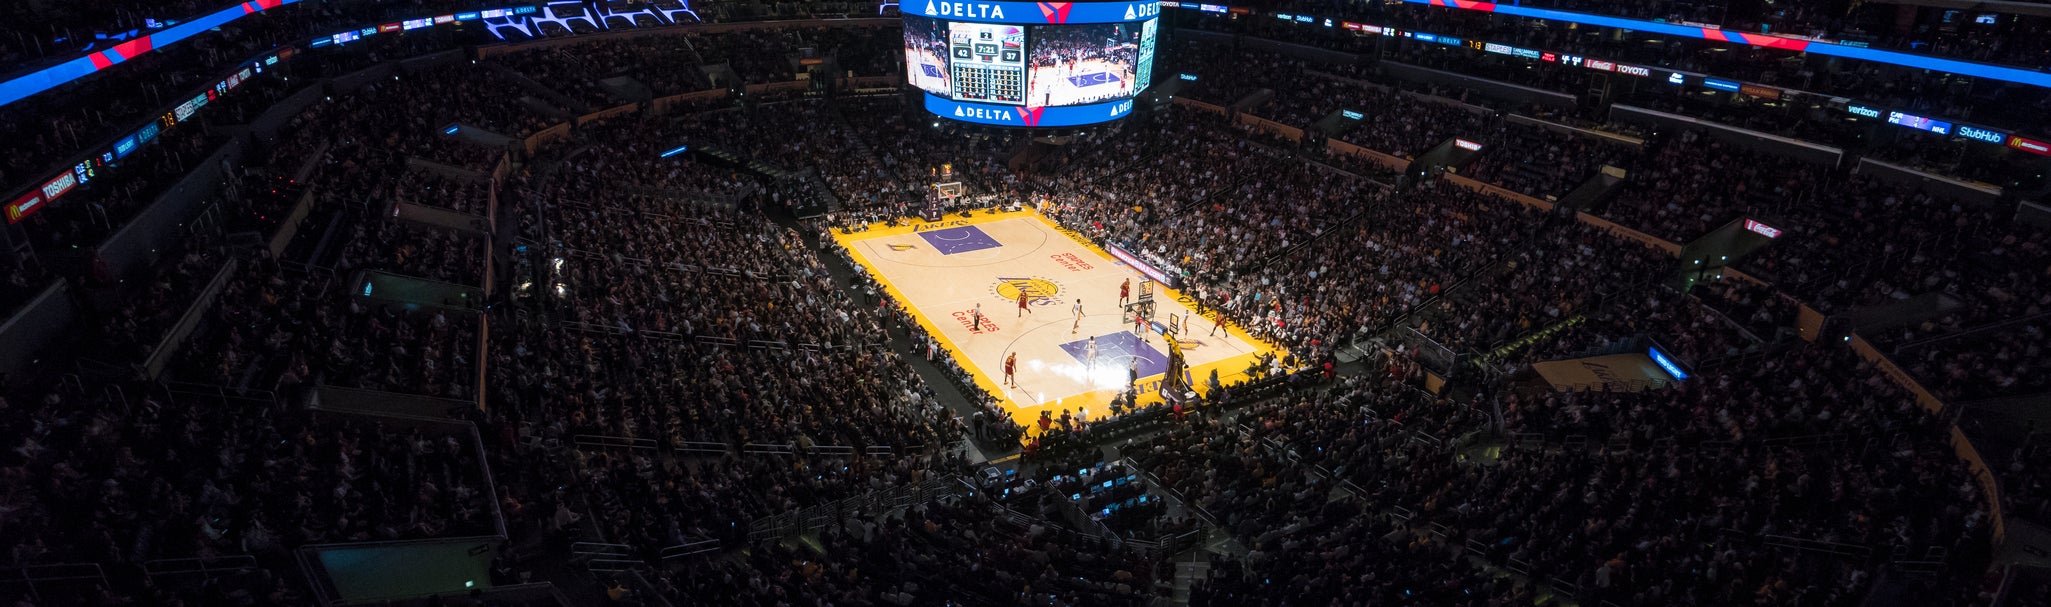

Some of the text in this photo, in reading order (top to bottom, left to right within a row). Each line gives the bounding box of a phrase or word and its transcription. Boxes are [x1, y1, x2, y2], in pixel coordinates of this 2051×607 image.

[941, 1, 1004, 19] DELTA
[957, 49, 968, 57] 42
[978, 46, 995, 54] 7:21
[1006, 52, 1017, 60] 37
[1617, 64, 1649, 77] TOYOTA
[966, 107, 1011, 121] DELTA
[1848, 105, 1878, 118] verizon
[1931, 126, 1946, 135] NHL
[1959, 126, 2001, 143] StubHub
[43, 173, 76, 199] TOSHIBA
[1050, 254, 1081, 272] Center
[1062, 252, 1094, 270] STAPLES
